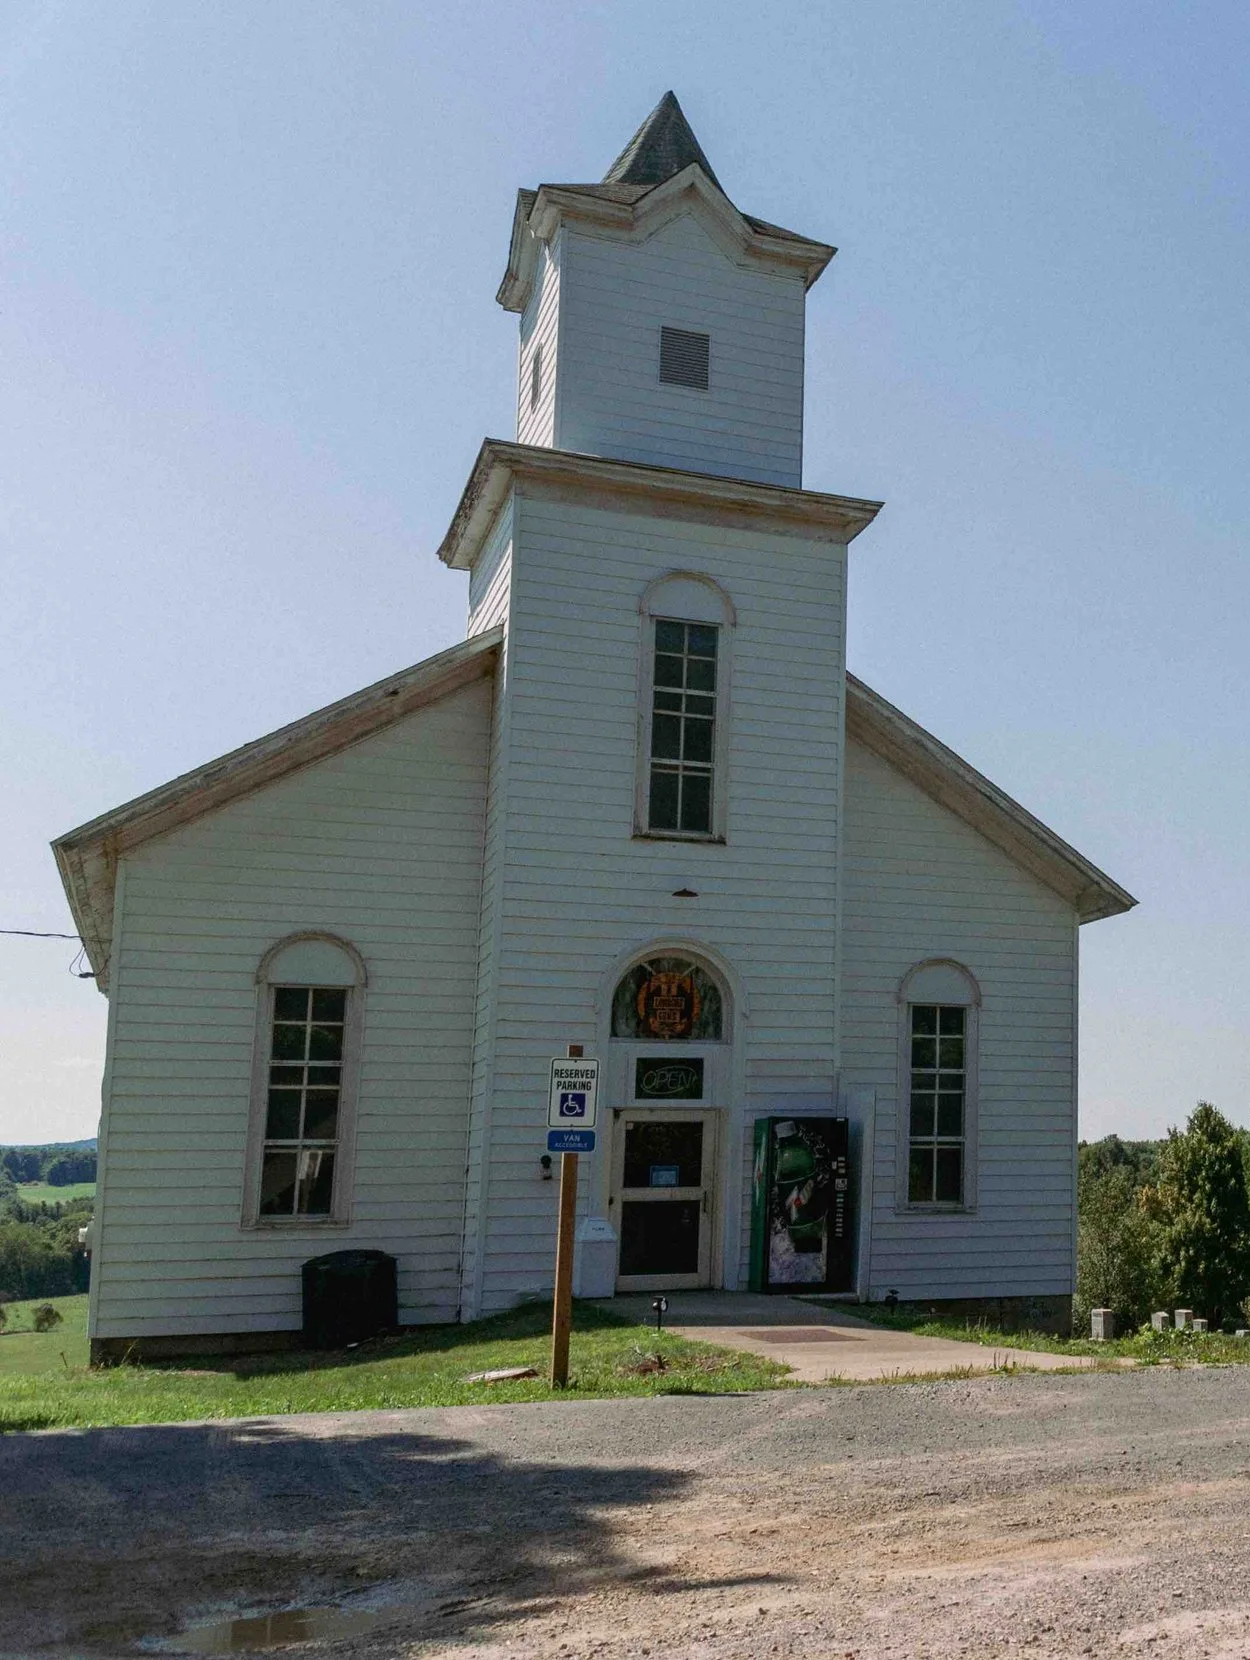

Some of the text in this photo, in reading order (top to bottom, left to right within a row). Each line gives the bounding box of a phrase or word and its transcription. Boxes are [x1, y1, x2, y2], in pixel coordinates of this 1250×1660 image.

[554, 1069, 595, 1079] RESERVED
[643, 1070, 692, 1089] OPEN
[556, 1081, 592, 1091] PARKING
[563, 1134, 580, 1142] VAN
